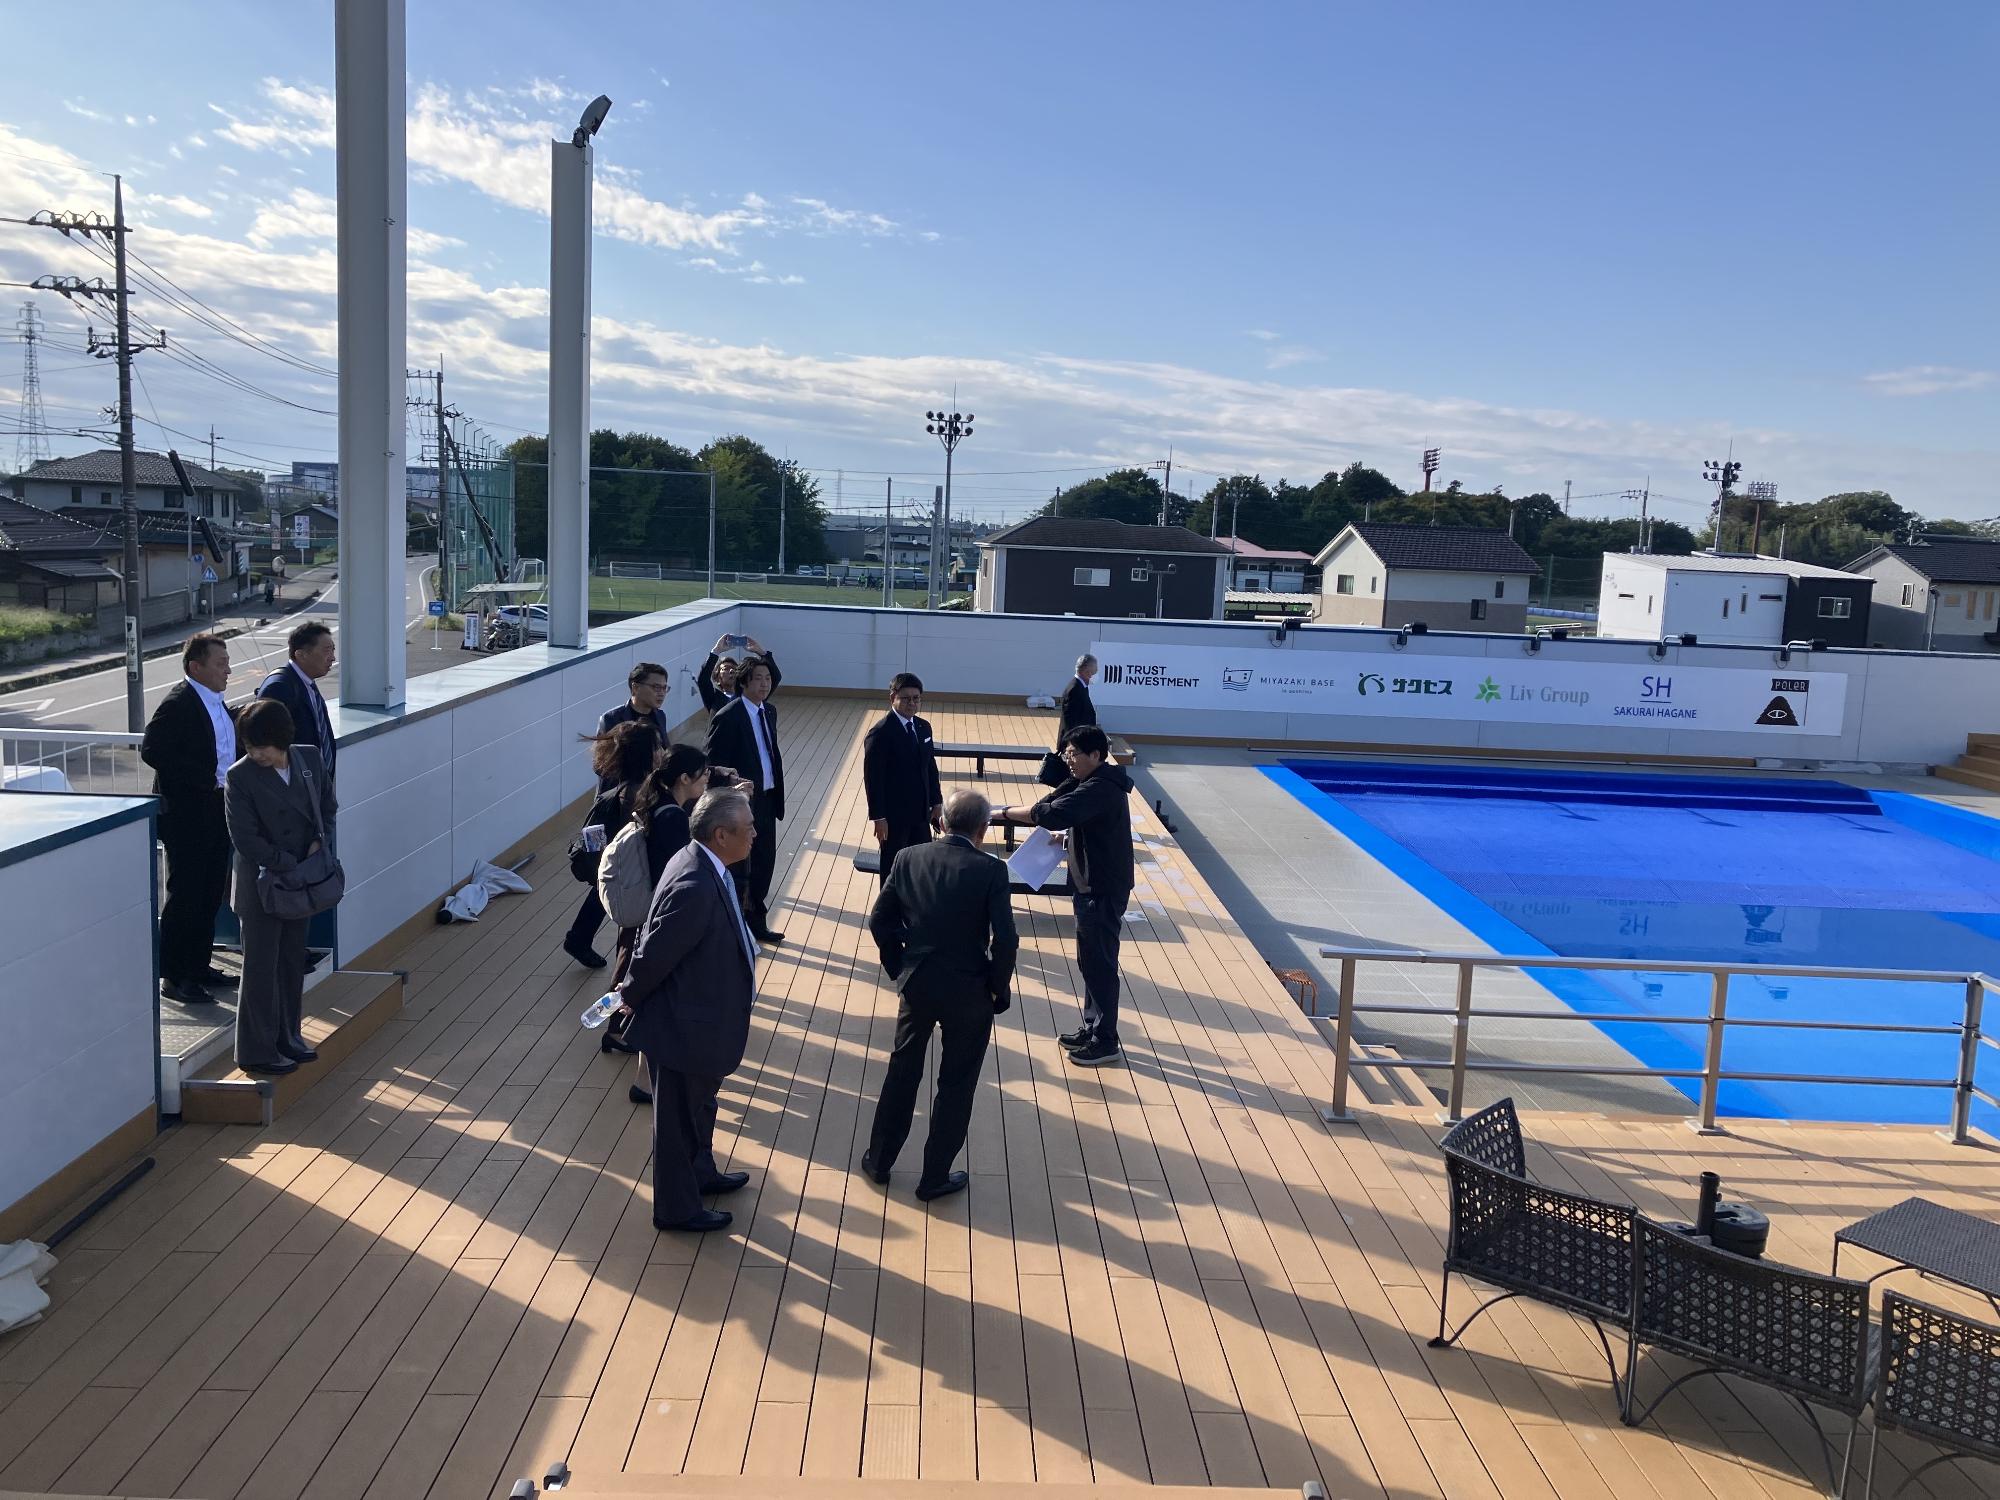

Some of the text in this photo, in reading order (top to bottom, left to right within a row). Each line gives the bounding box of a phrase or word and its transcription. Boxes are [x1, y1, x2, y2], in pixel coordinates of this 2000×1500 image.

[1126, 664, 1167, 676] TRUST
[1125, 676, 1200, 688] INVESTMENT
[1260, 677, 1335, 687] MIYAZAKI BASE
[1391, 678, 1453, 695] サクセス
[1640, 676, 1672, 698] SH
[1509, 684, 1590, 707] Liv Group
[1613, 706, 1697, 719] SAKURAI HAGANE
